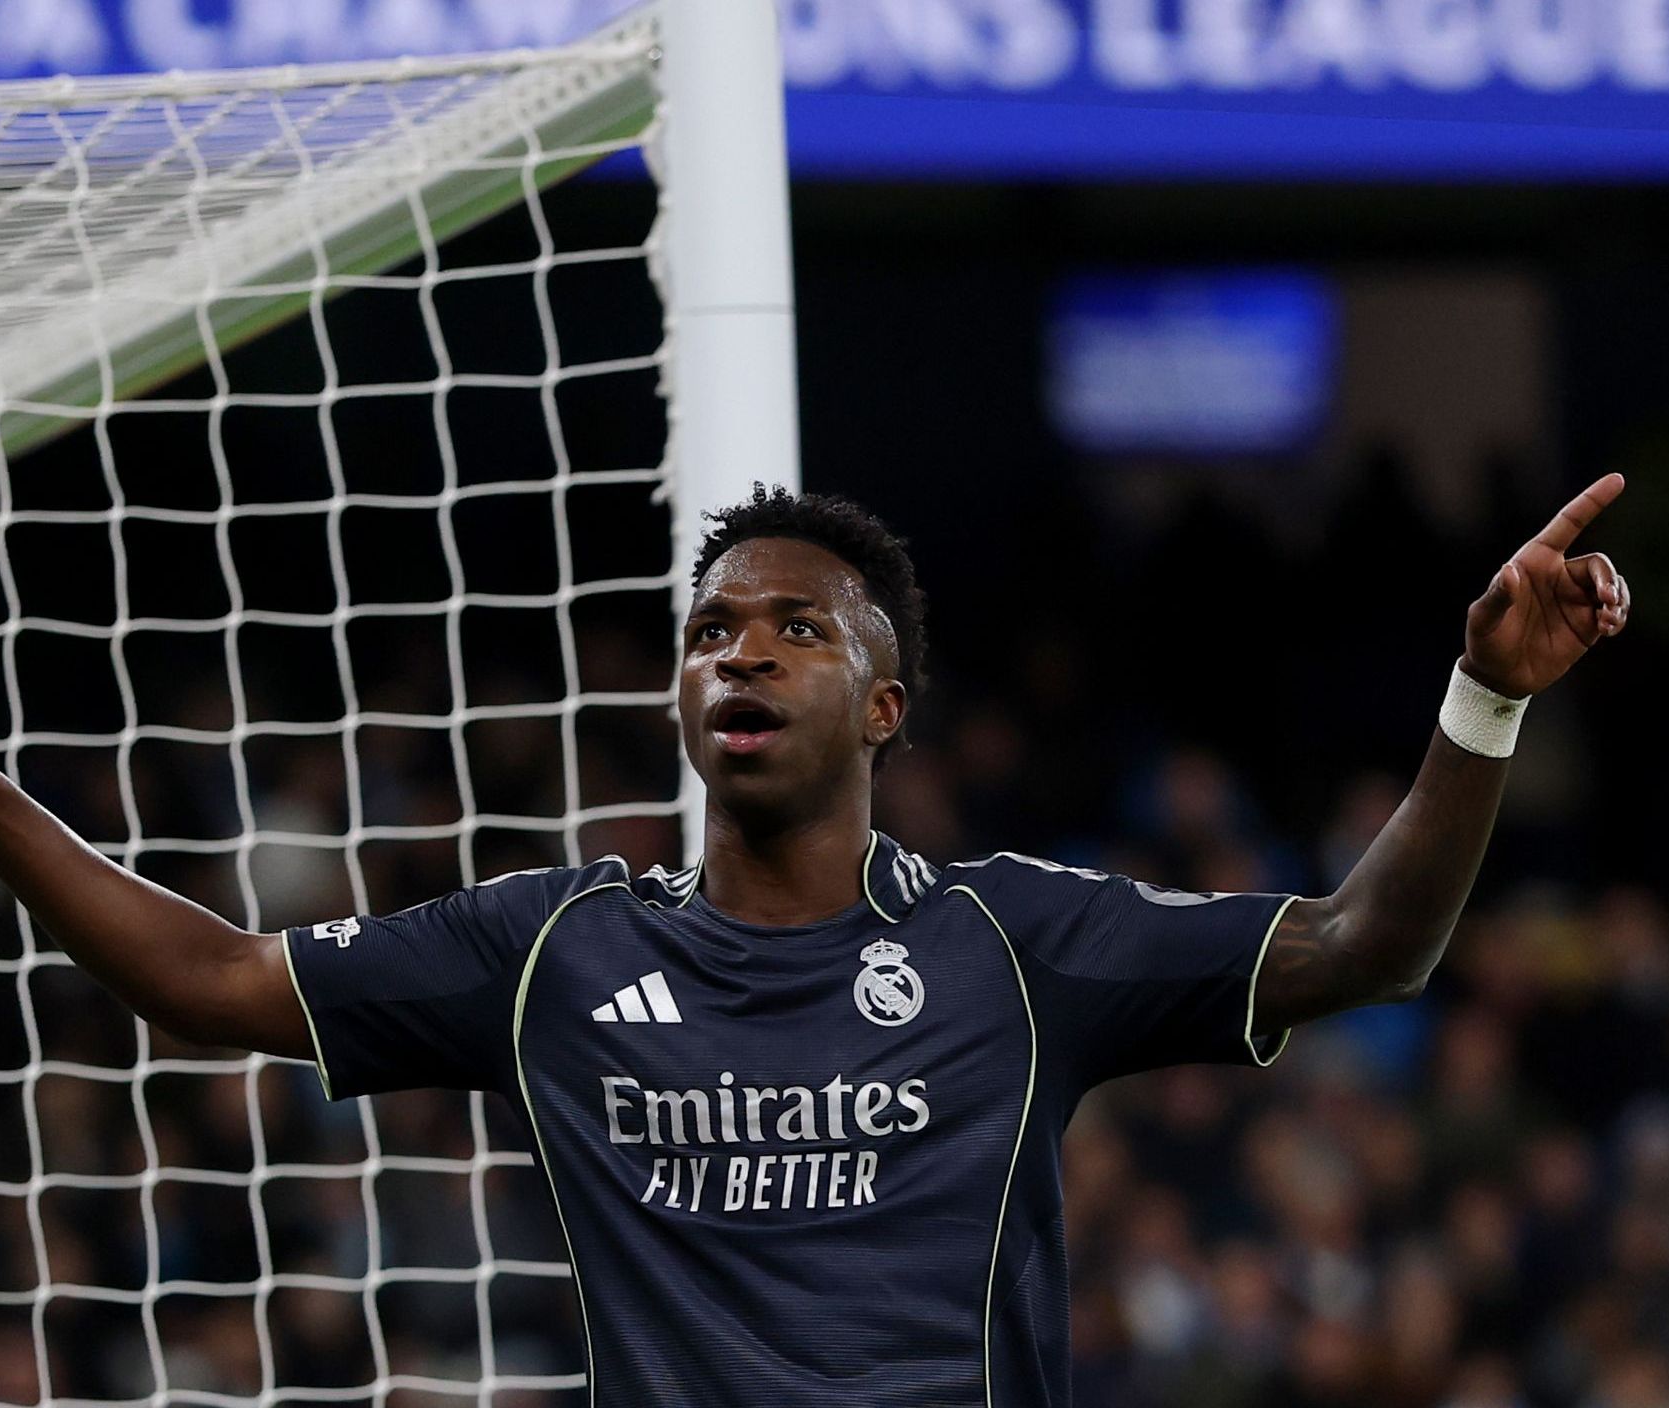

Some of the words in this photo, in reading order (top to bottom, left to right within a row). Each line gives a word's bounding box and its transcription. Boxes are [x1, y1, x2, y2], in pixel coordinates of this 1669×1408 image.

[599, 1071, 930, 1145] Emirates
[640, 1157, 710, 1213] FLY
[723, 1150, 879, 1212] BETTER
